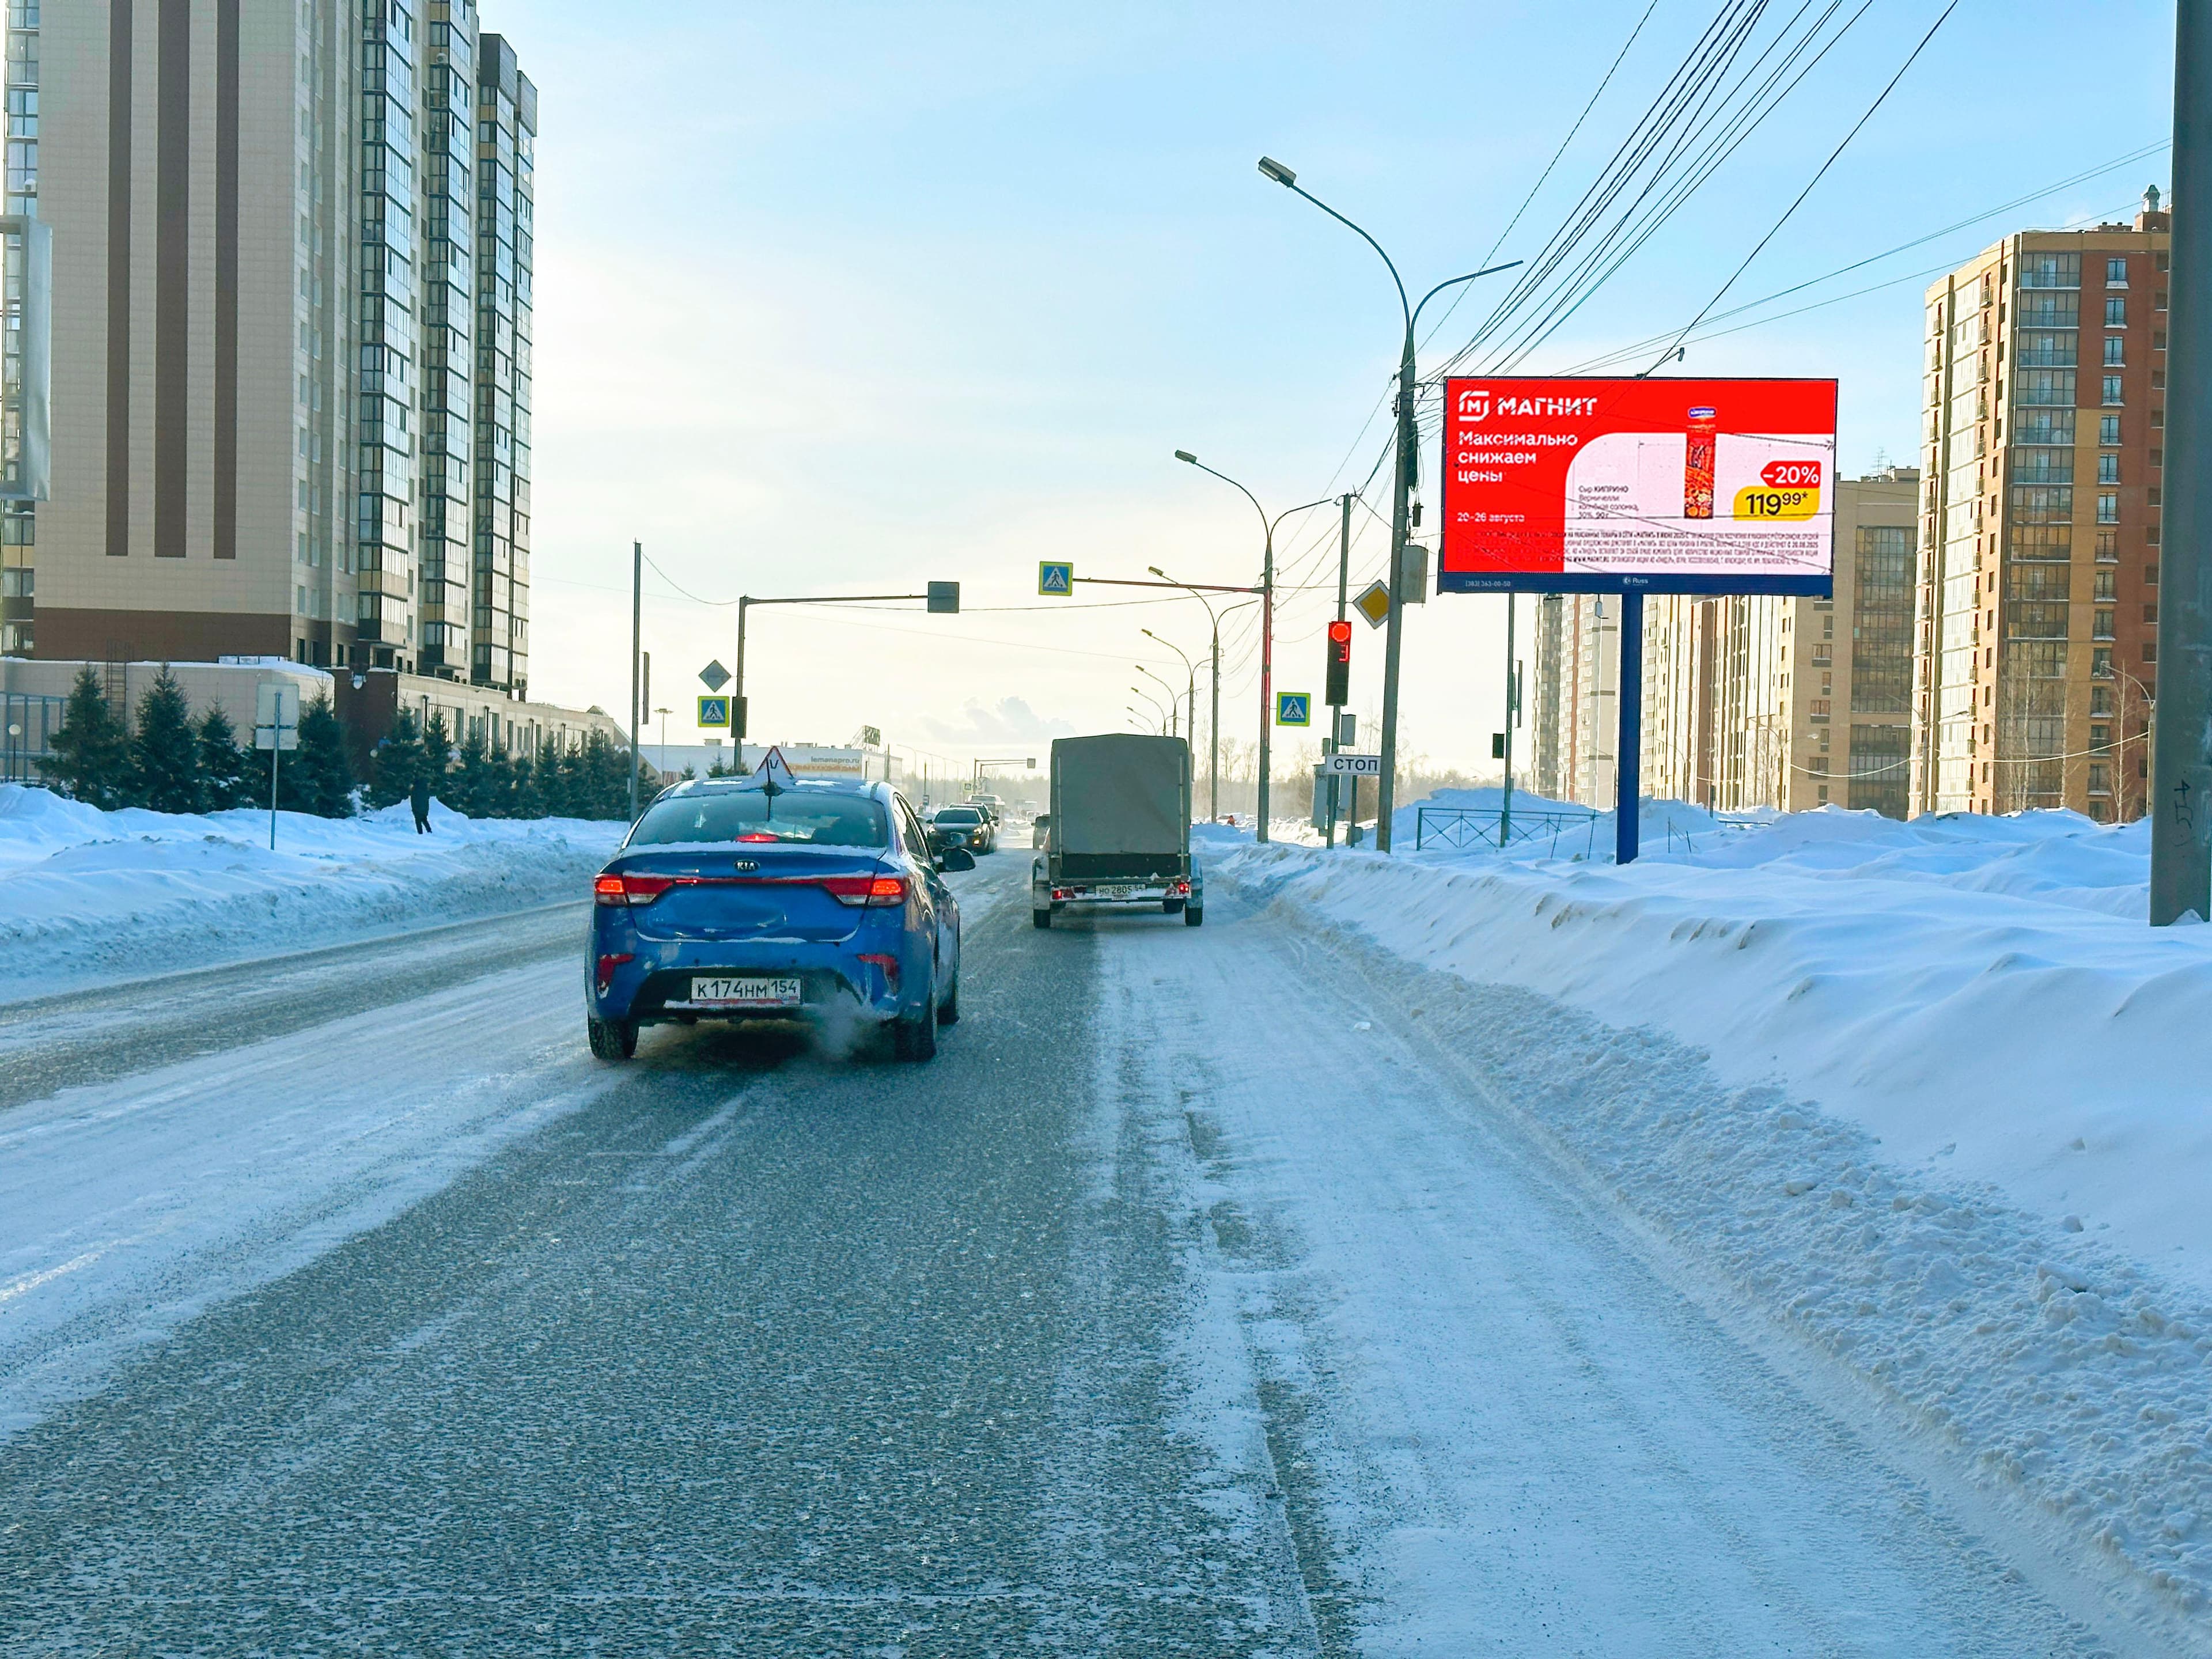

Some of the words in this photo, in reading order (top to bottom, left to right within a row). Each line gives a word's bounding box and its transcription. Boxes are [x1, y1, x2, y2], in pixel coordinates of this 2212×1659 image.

[1497, 397, 1597, 416] МАГНИТ
[1459, 431, 1578, 446] Максимально
[1458, 452, 1536, 464] снижаем
[1458, 470, 1502, 484] цены
[1763, 466, 1819, 484] -20%
[1488, 513, 1525, 524] августа
[811, 756, 860, 764] lemanapro.ru
[1334, 758, 1378, 771] СТОП
[737, 862, 755, 870] KIA
